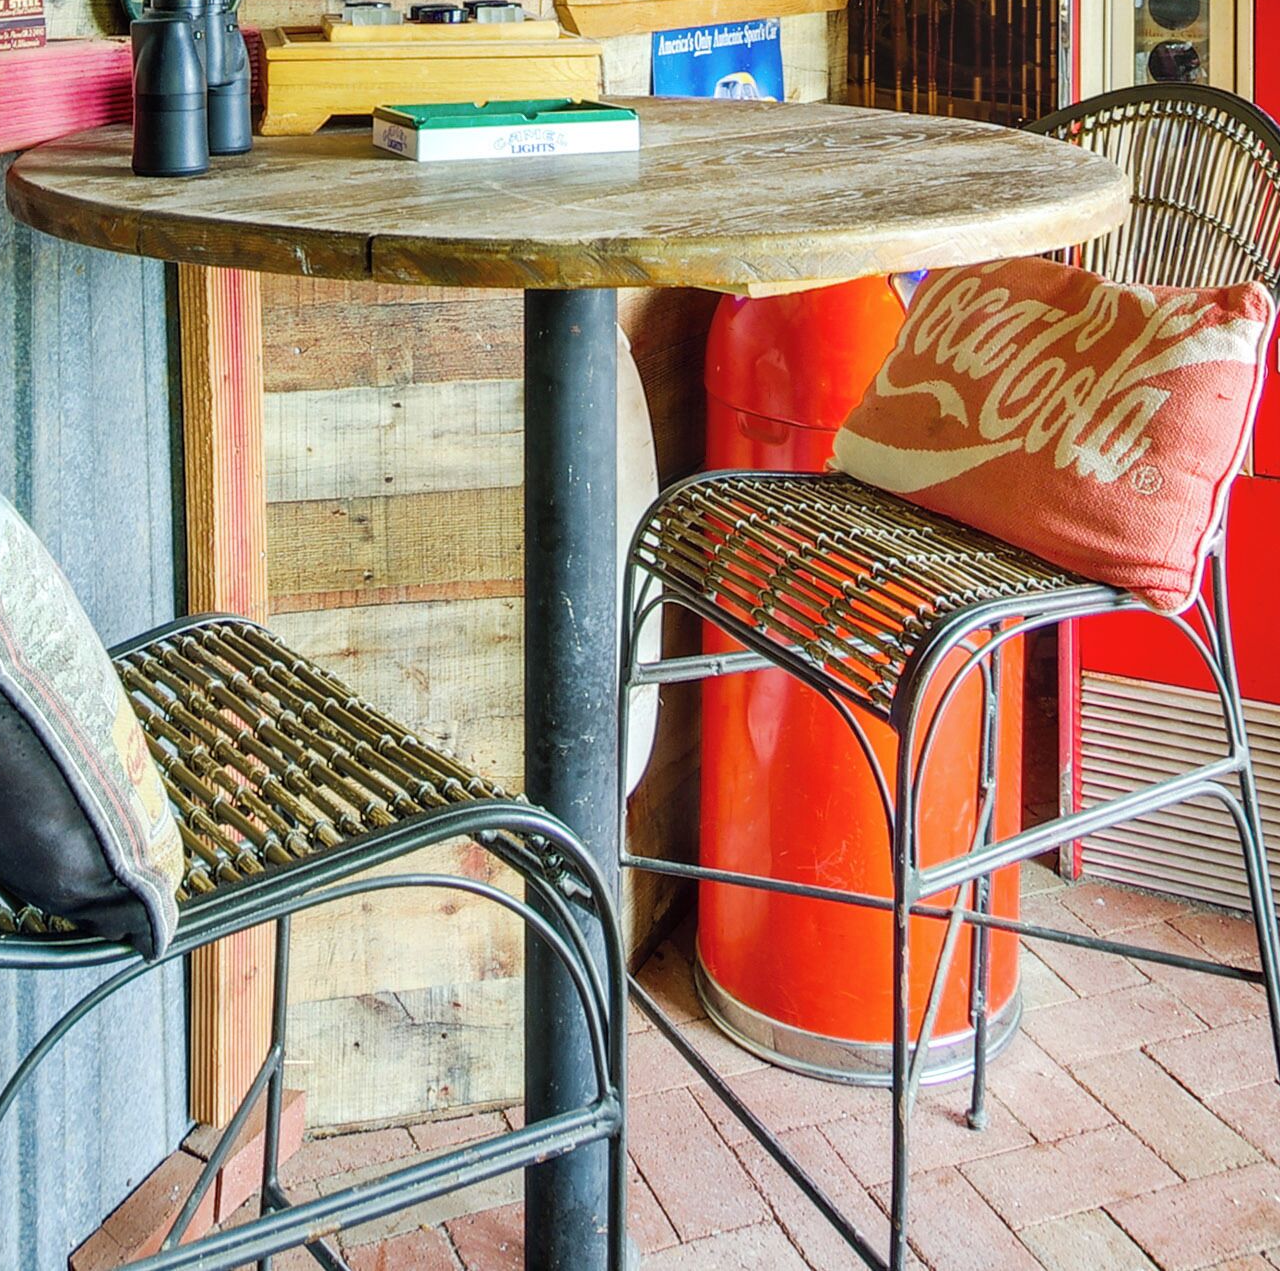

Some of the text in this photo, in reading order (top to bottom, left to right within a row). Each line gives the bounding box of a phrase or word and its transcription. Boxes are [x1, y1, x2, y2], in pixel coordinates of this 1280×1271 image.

[657, 31, 695, 57] America's
[694, 29, 713, 51] Only
[712, 26, 744, 48] Authentic
[765, 22, 778, 40] Car
[493, 127, 569, 151] CAMEL
[510, 143, 556, 155] LIGHTS
